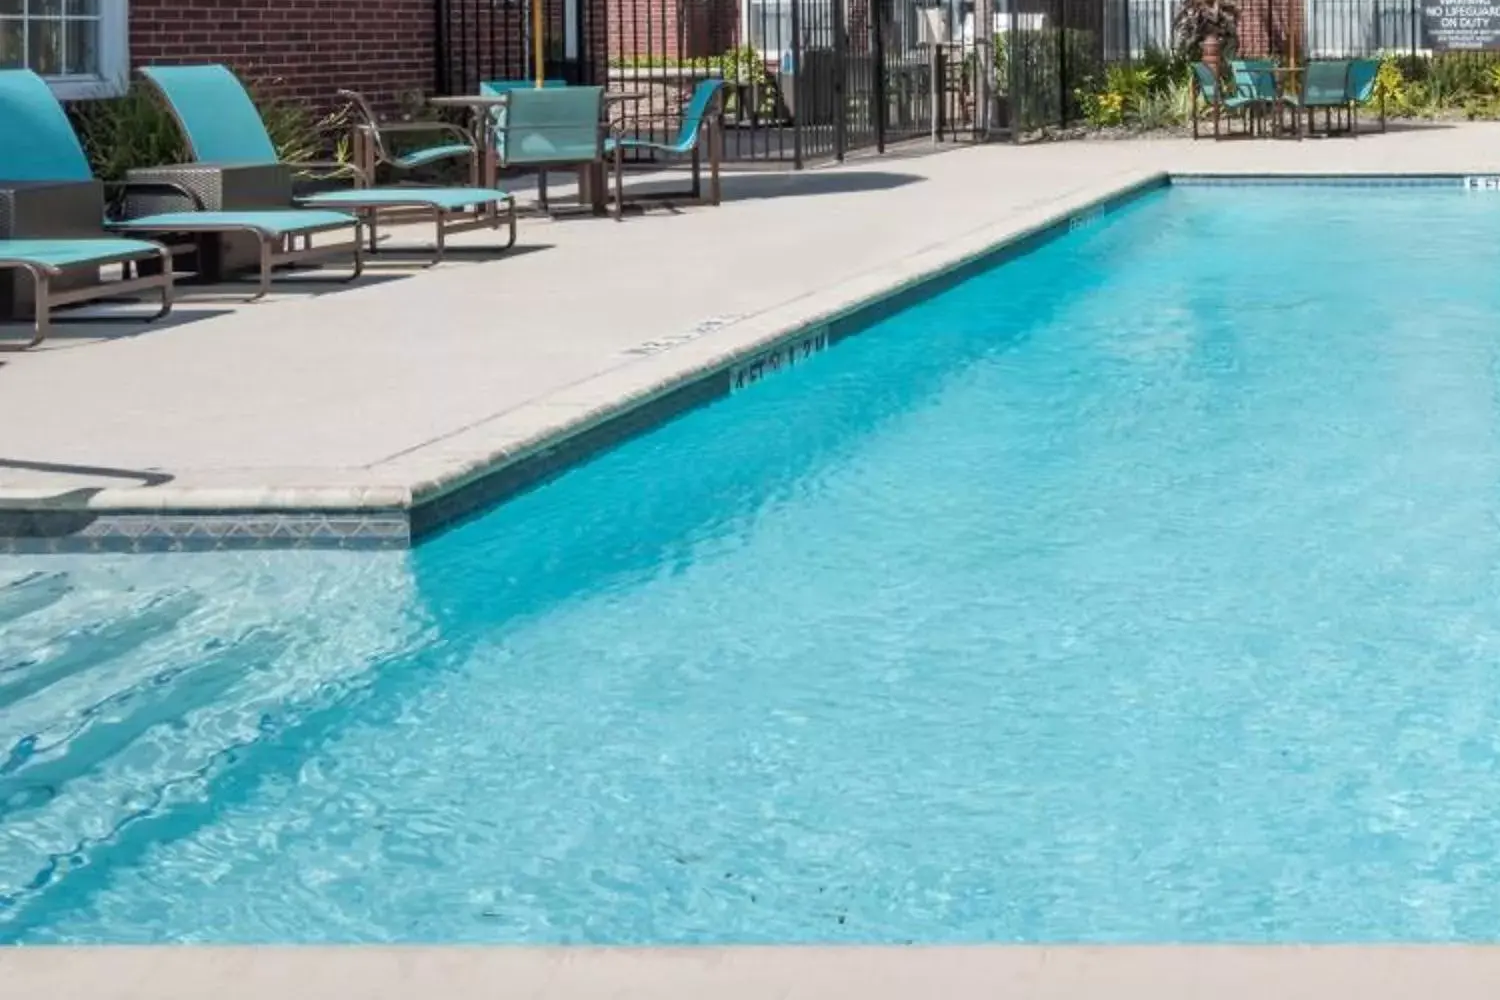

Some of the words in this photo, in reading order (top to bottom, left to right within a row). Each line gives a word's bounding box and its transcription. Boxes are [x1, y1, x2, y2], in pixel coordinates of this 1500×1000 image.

[1426, 6, 1443, 17] NO
[1441, 18, 1457, 28] ON
[1459, 17, 1490, 28] DUTY
